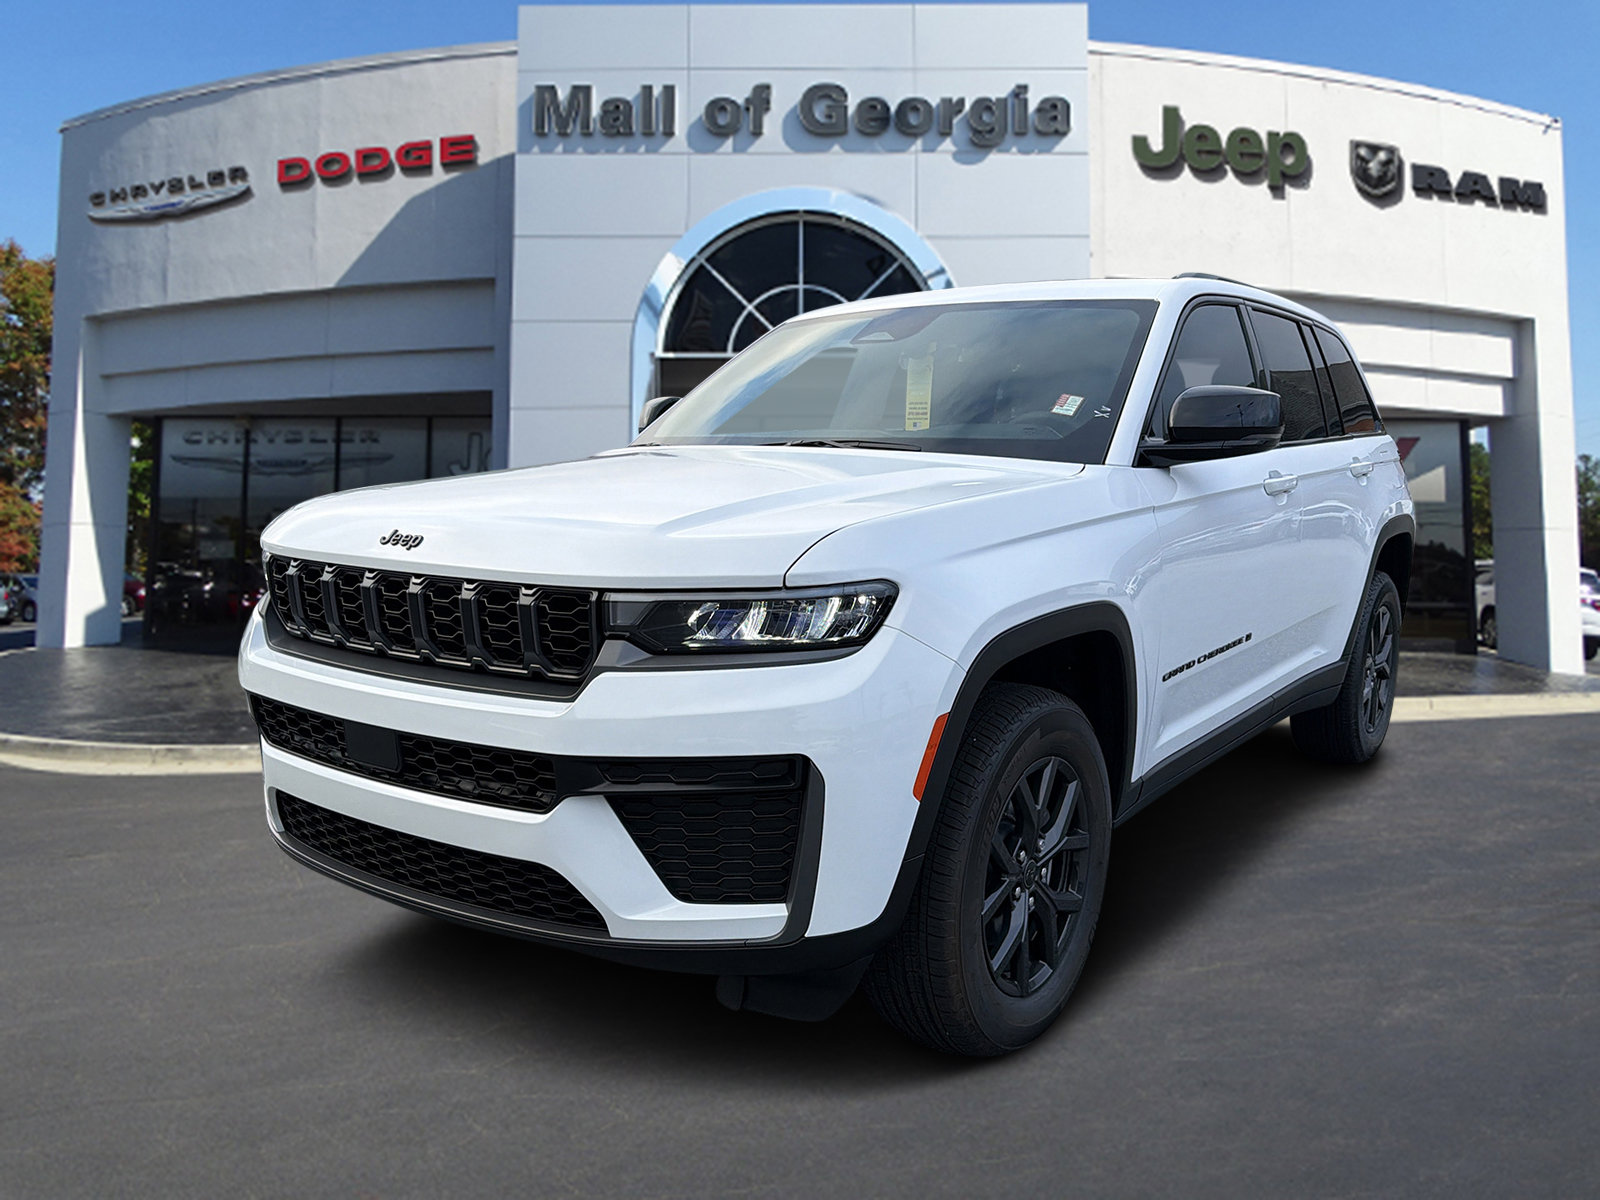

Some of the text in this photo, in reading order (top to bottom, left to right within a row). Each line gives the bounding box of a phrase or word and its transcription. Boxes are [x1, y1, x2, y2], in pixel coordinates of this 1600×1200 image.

[534, 82, 1072, 149] Mall of Georgia
[278, 134, 476, 185] DODGE
[1131, 104, 1309, 193] Jeep
[89, 165, 250, 207] CHRYSLER
[1410, 162, 1547, 214] RAM
[182, 429, 381, 444] CHRYSLER
[380, 529, 424, 551] Jeep
[1162, 636, 1245, 682] GRAND CHEROKEE
